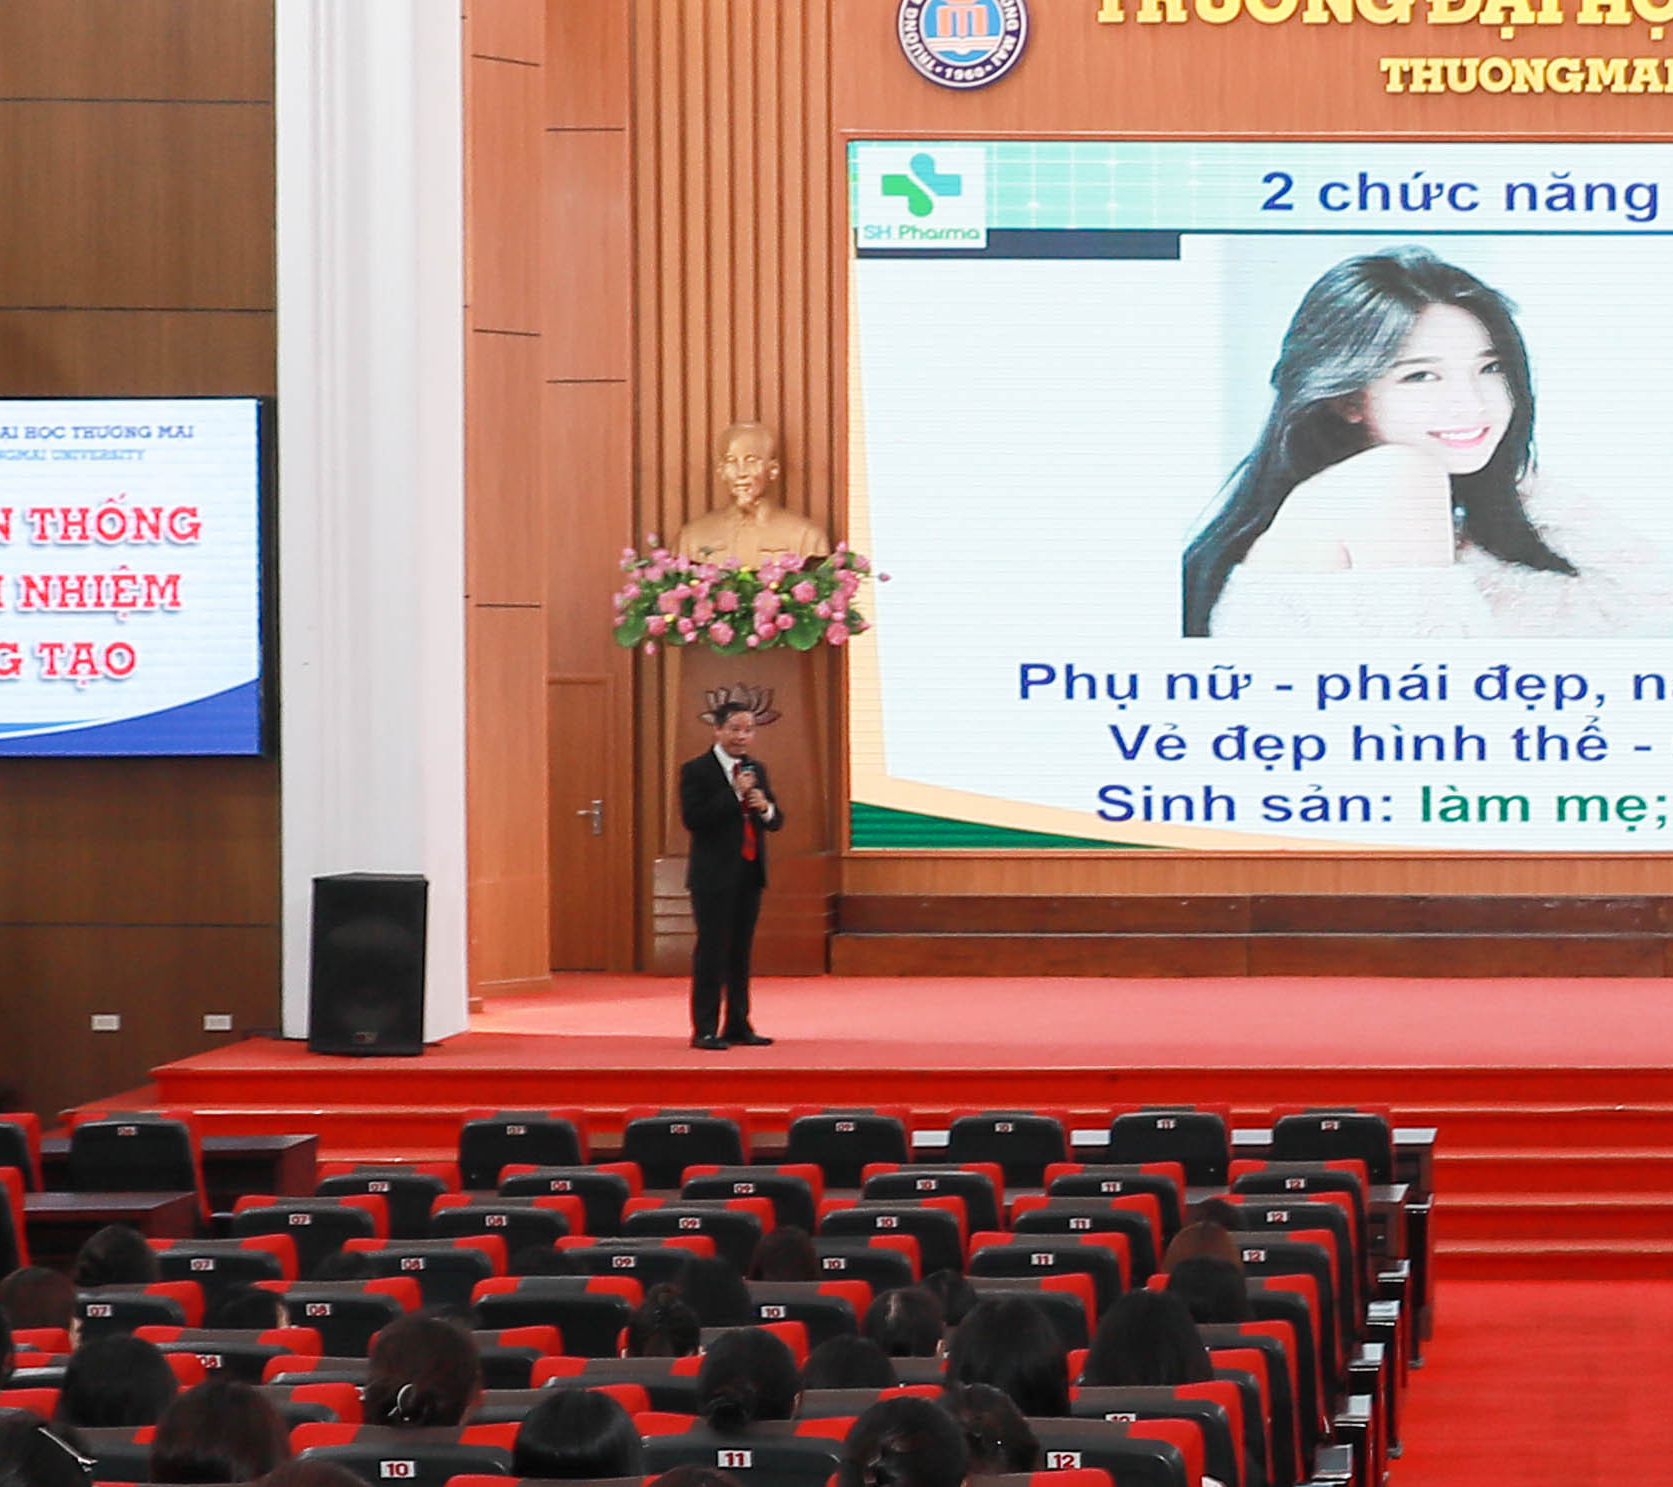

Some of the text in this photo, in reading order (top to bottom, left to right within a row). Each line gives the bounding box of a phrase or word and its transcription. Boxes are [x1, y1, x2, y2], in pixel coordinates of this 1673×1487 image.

[1261, 171, 1294, 211] 2
[1318, 171, 1479, 212] chức
[1505, 171, 1658, 223] năng
[863, 224, 981, 240] SH Pharma
[29, 493, 203, 542] THỐNG
[21, 565, 182, 619] NHIỆM
[38, 641, 137, 686] TẠO
[1019, 663, 1139, 711] Phụ
[1166, 664, 1252, 701] nữ
[1317, 663, 1448, 711] phái
[1474, 663, 1605, 711] đẹp,
[1109, 723, 1187, 762] Vẻ
[1212, 724, 1327, 772] đẹp
[1352, 724, 1487, 762] hình
[1511, 716, 1608, 762] thể
[1097, 784, 1236, 822] Sinh
[1262, 784, 1392, 823] sản:
[1421, 784, 1530, 823] làm
[1556, 794, 1667, 833] mẹ;
[725, 1451, 745, 1467] 11
[1053, 1453, 1076, 1469] 12
